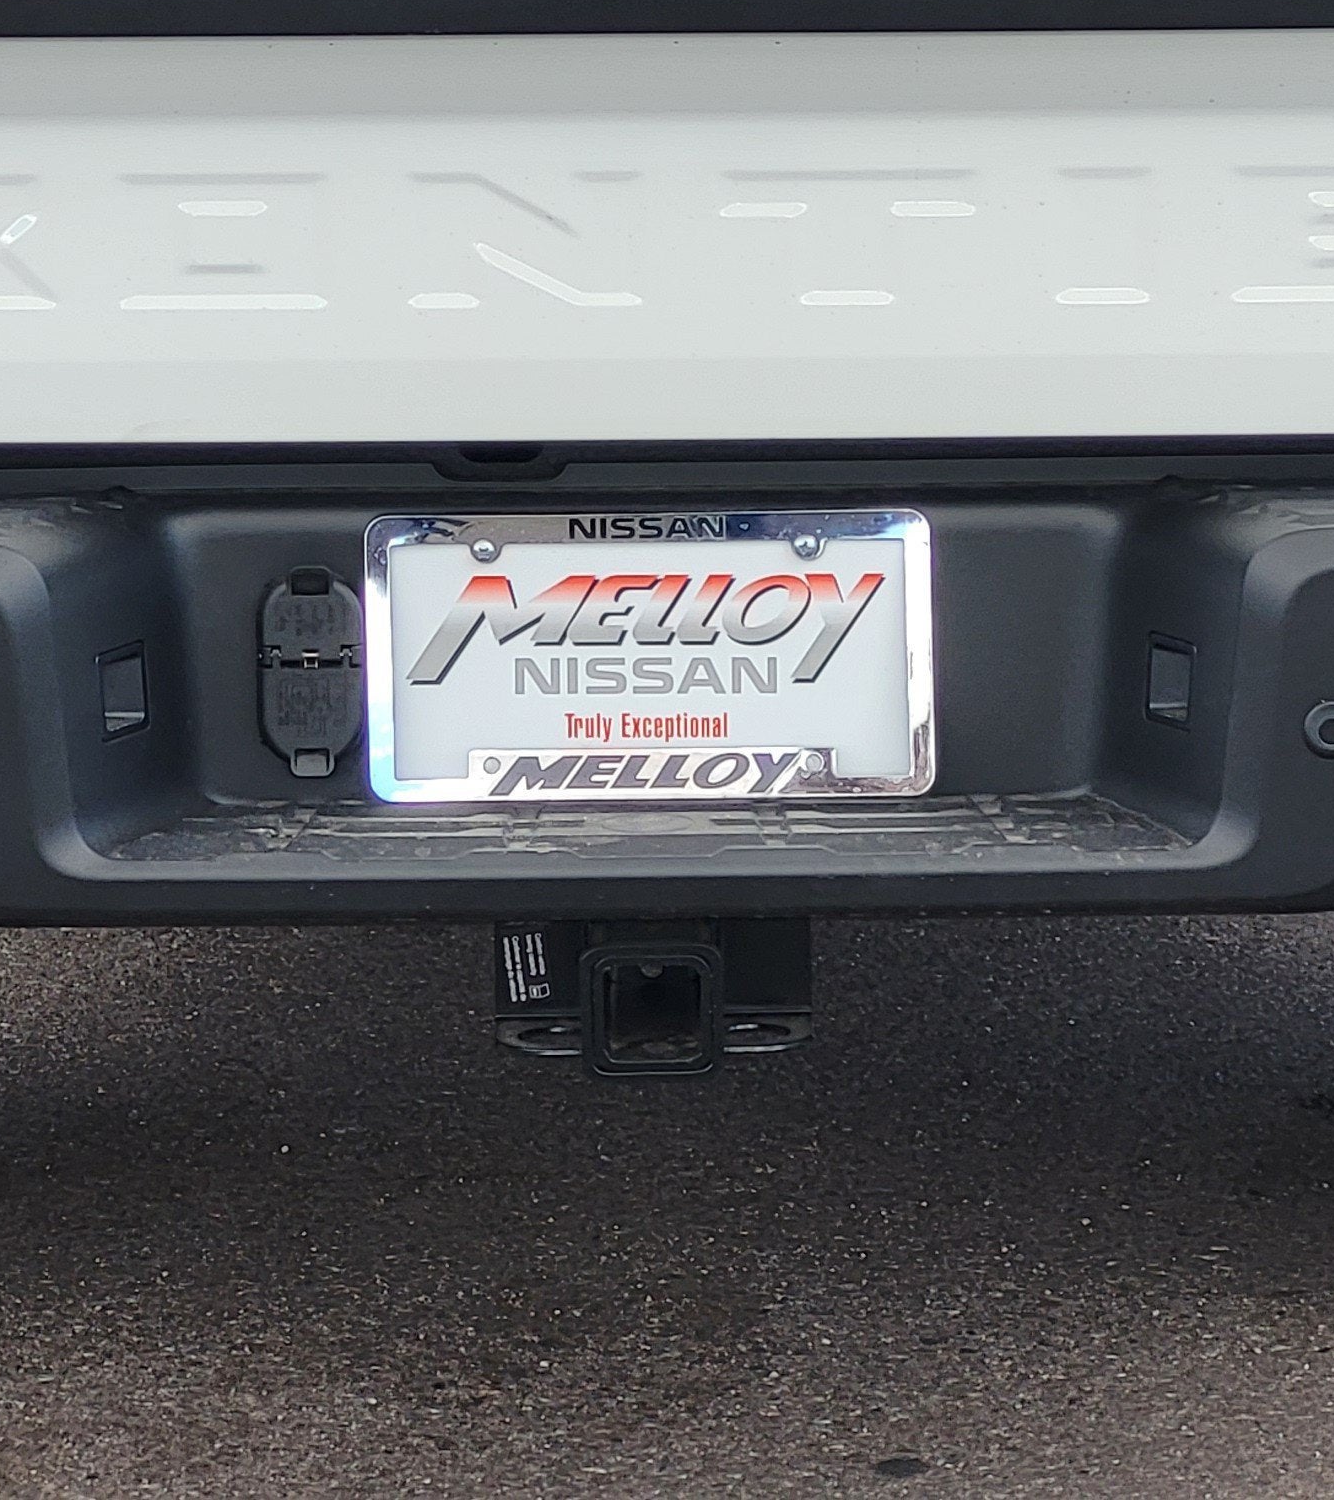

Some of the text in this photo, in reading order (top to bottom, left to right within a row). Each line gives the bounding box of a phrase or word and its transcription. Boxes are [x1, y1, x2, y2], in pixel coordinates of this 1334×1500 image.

[568, 515, 725, 540] NISSAN
[406, 573, 885, 686] MELLOY
[514, 656, 779, 695] NISSAN
[564, 712, 729, 743] Truly Exceptional
[488, 751, 800, 797] MELLOY
